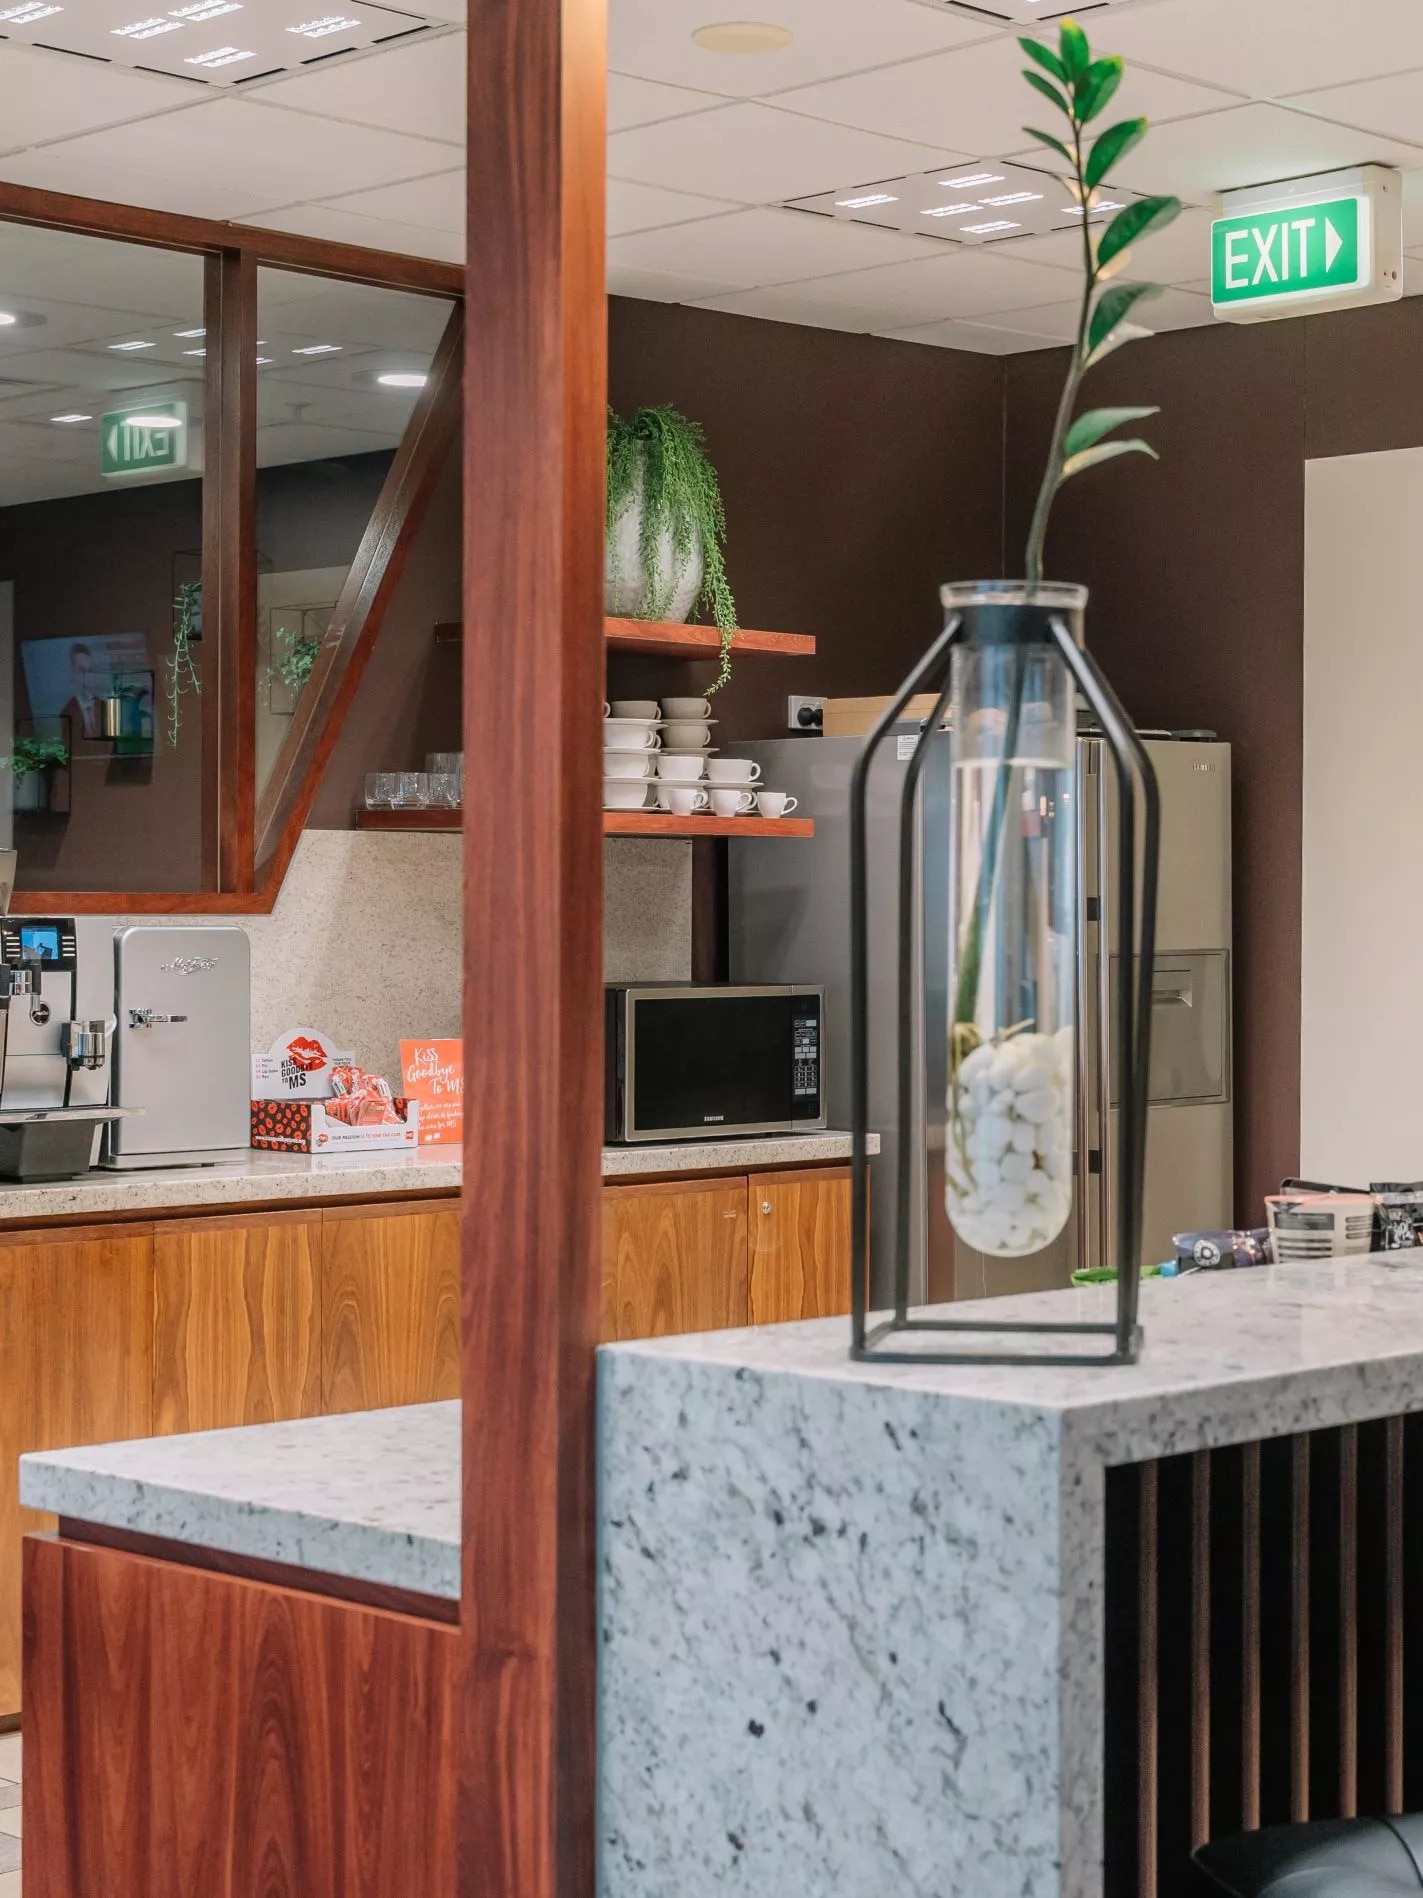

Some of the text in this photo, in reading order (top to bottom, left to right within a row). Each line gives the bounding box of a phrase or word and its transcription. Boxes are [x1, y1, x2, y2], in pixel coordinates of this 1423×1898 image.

[1224, 217, 1316, 290] EXIT
[281, 1057, 297, 1069] KISS
[414, 1046, 439, 1066] Kiss
[281, 1062, 313, 1078] GOODBYE
[407, 1061, 455, 1084] Goodbye
[288, 1072, 307, 1090] MS
[431, 1077, 443, 1095] To
